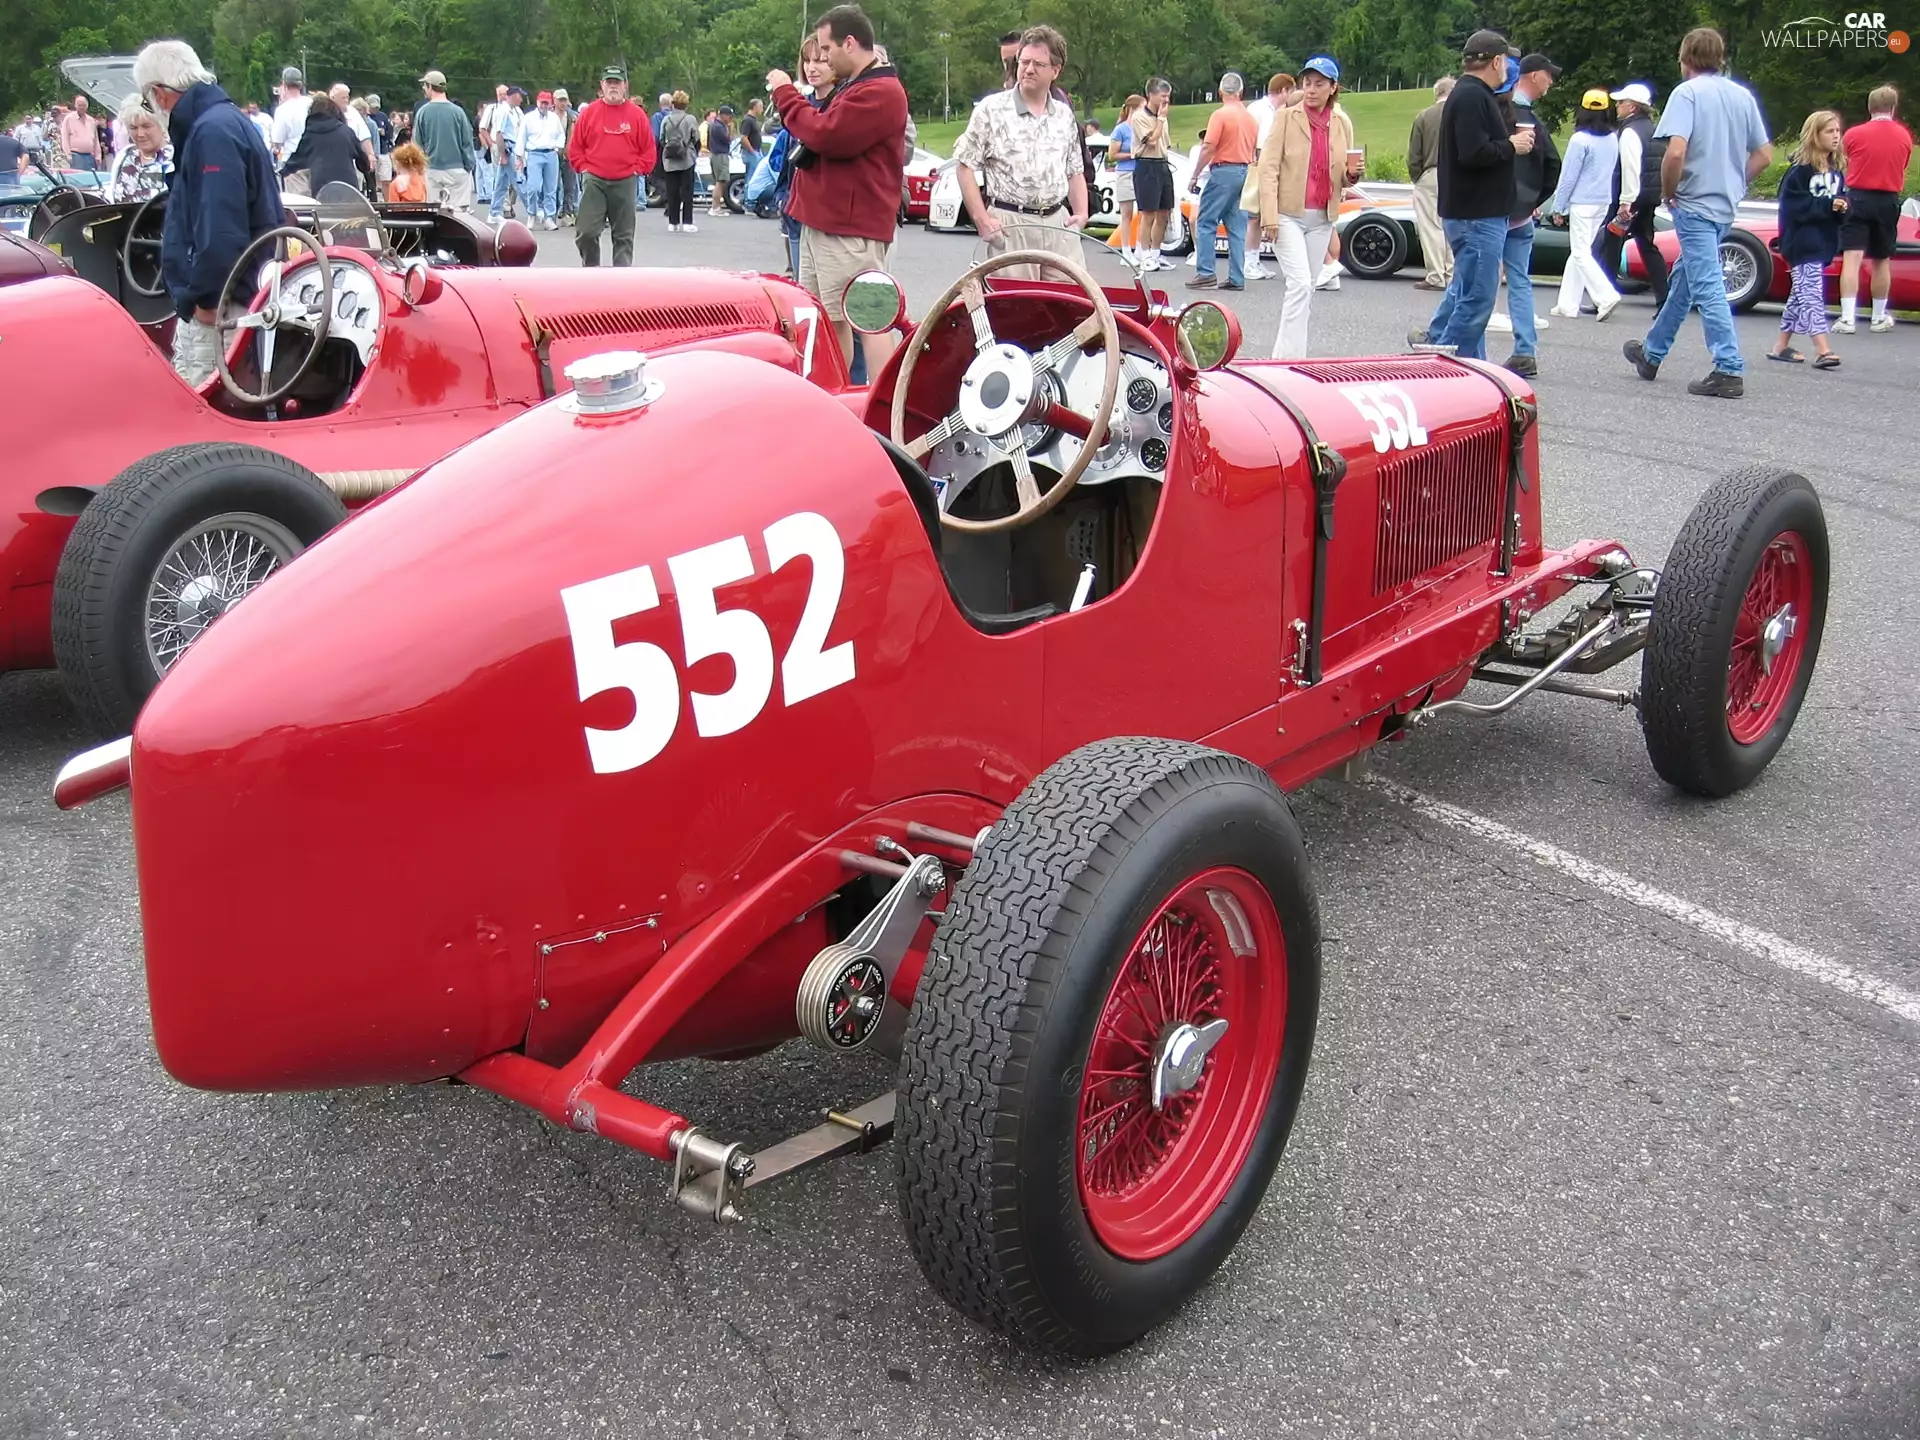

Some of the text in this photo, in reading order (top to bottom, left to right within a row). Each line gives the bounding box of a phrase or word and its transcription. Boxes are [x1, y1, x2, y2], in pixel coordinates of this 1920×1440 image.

[793, 307, 818, 379] 7
[1339, 382, 1429, 454] 552
[560, 511, 857, 775] 552
